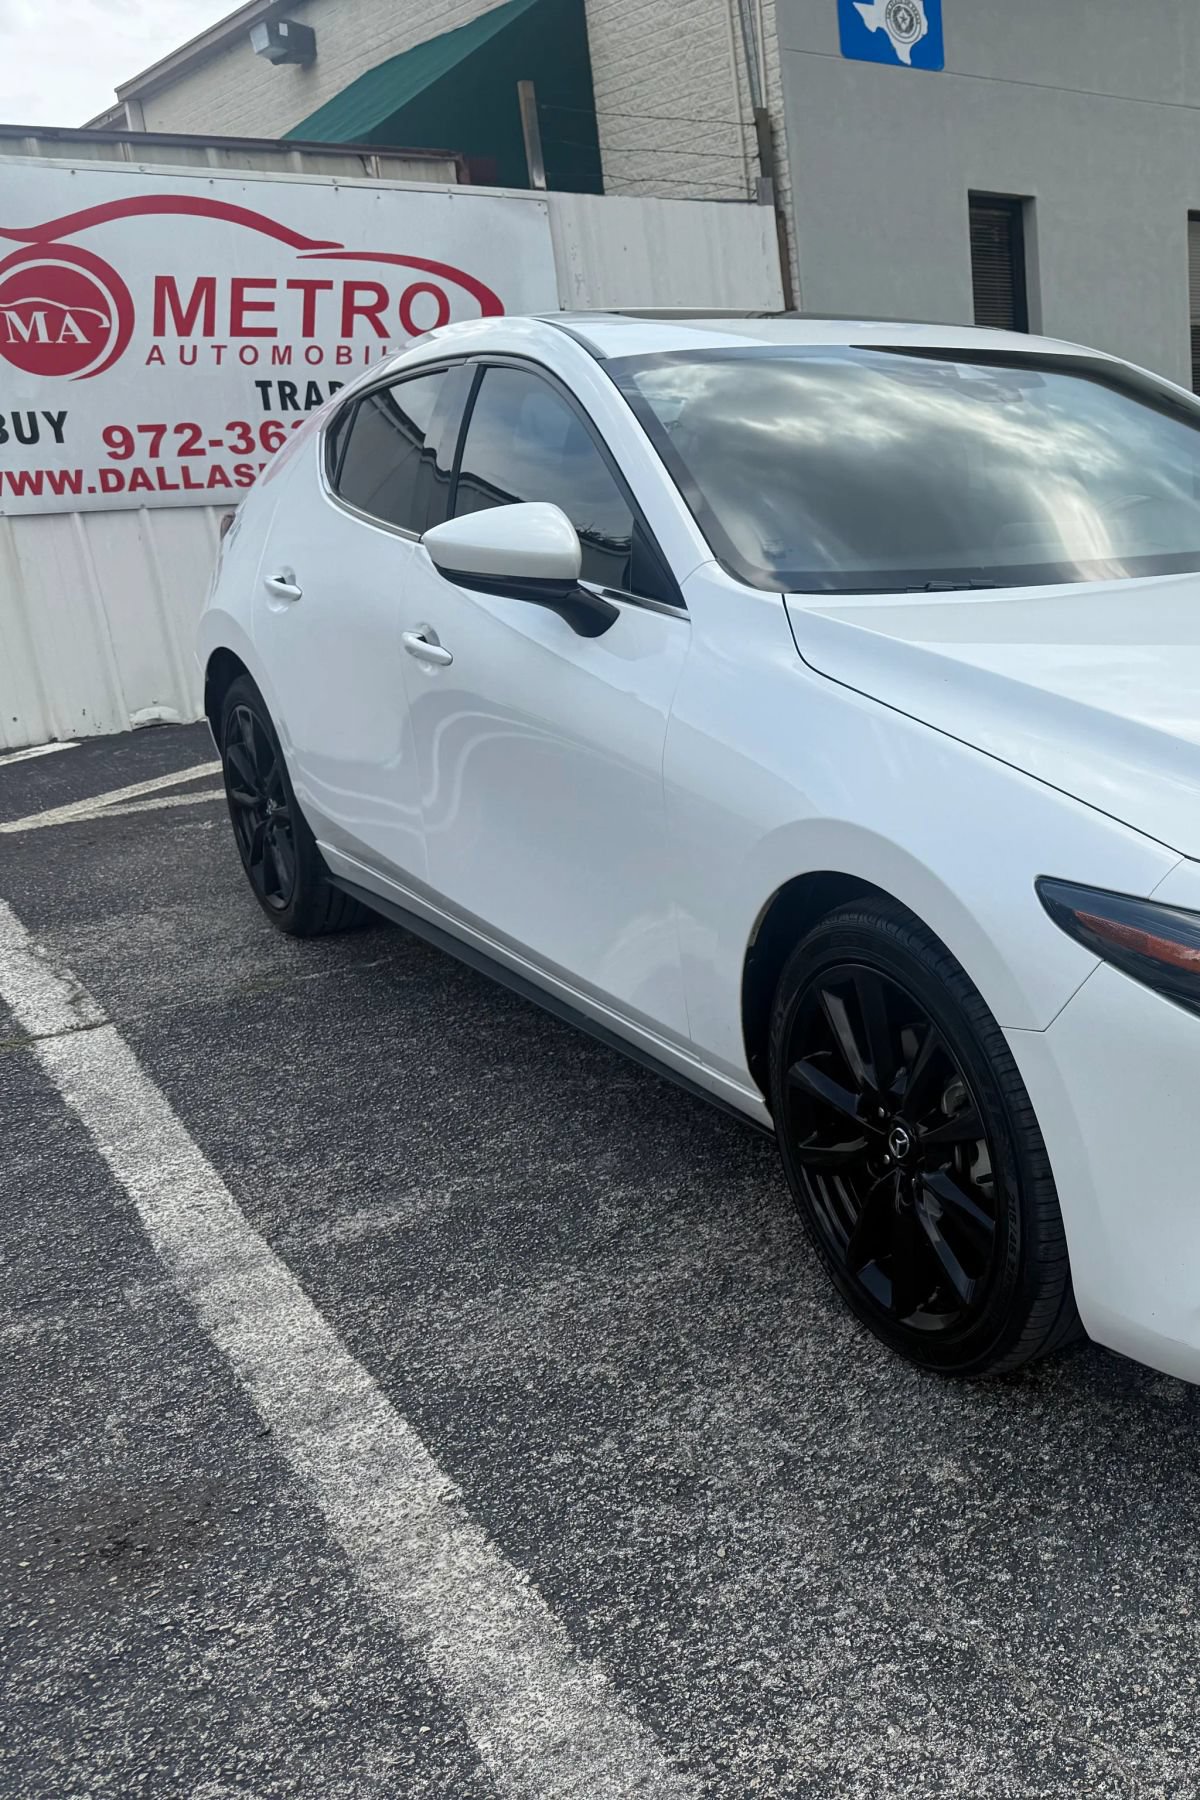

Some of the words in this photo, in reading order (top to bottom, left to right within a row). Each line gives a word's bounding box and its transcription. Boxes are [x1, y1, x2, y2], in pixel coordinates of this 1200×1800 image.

[153, 275, 451, 338] METRO
[0, 310, 91, 343] MA
[145, 344, 388, 366] AUTOMOBI
[102, 419, 306, 461] 972-36
[0, 463, 266, 497] WW.DALLAS
